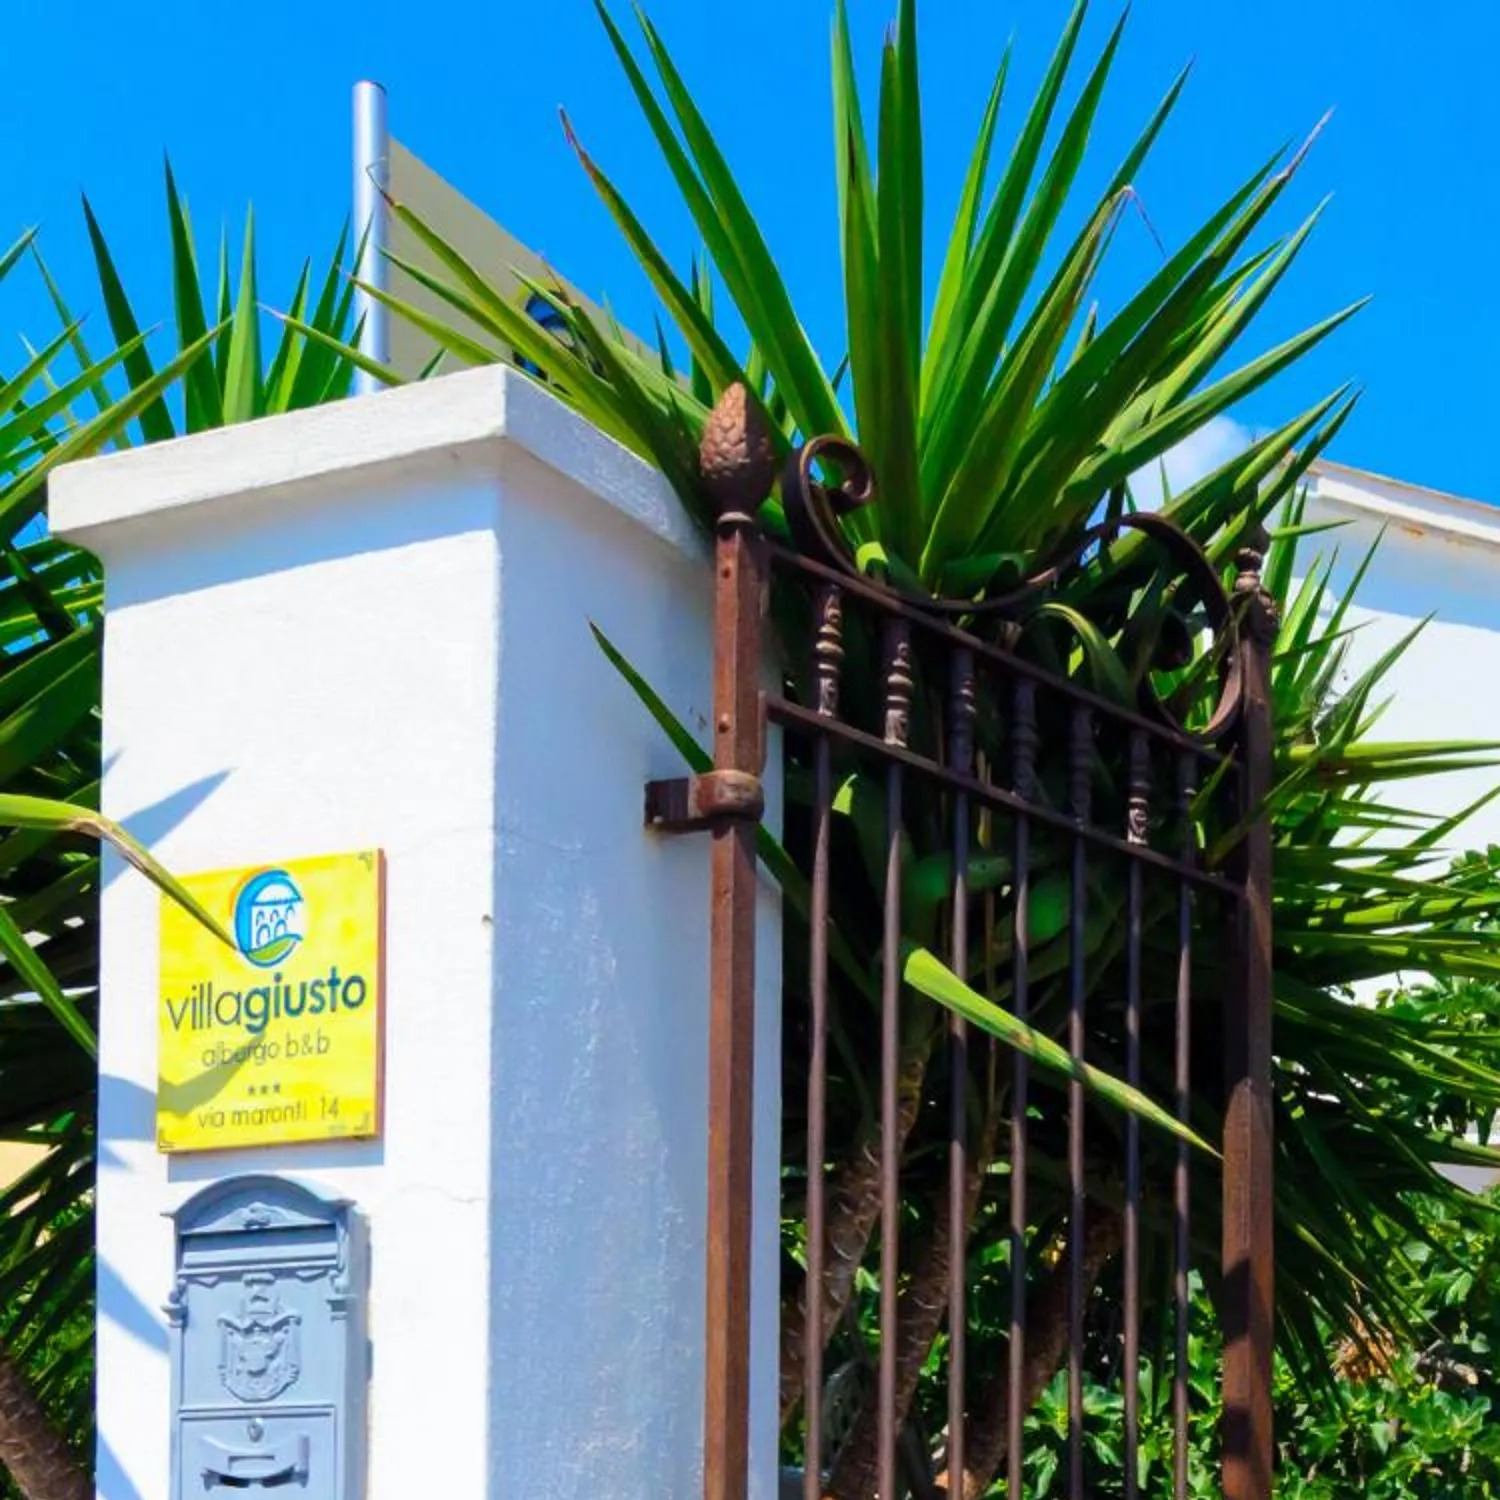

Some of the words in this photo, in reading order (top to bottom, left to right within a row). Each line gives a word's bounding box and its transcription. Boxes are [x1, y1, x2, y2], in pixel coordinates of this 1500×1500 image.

[166, 965, 367, 1034] villagiusto
[285, 1028, 331, 1060] b&b
[197, 1106, 226, 1130] via
[319, 1094, 340, 1121] 14
